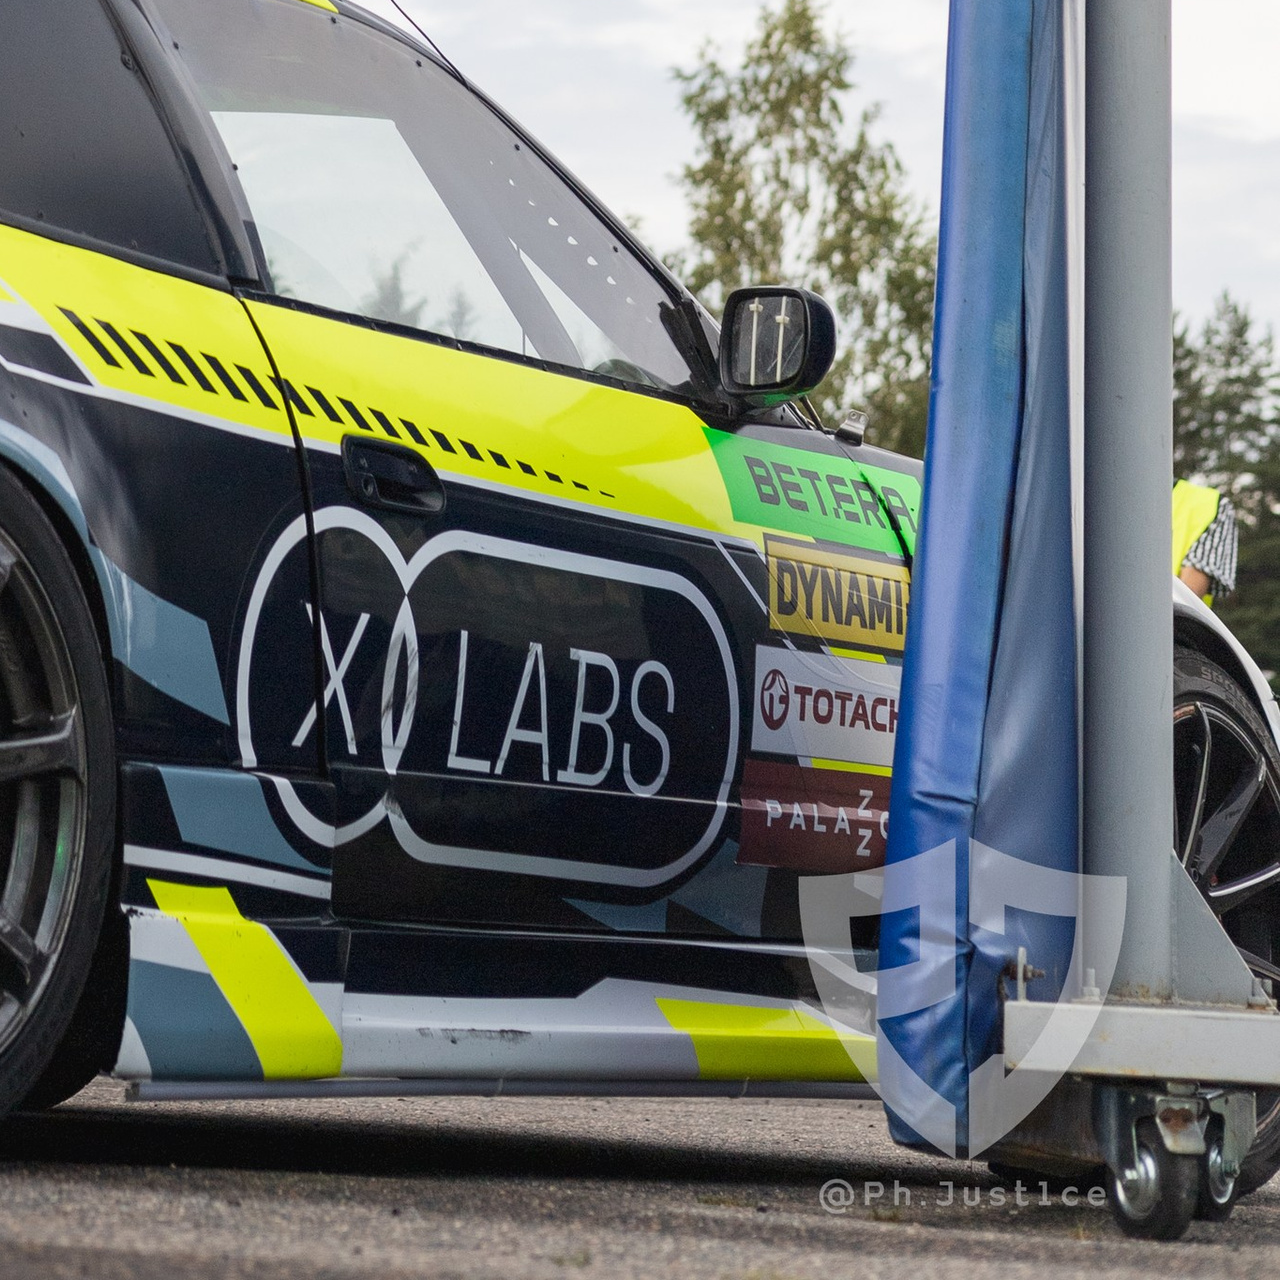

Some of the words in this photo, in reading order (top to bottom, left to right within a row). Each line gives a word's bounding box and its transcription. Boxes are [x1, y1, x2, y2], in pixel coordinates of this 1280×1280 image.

[743, 454, 917, 534] BETERA
[776, 558, 909, 635] DYNAMI
[447, 630, 675, 797] LABS
